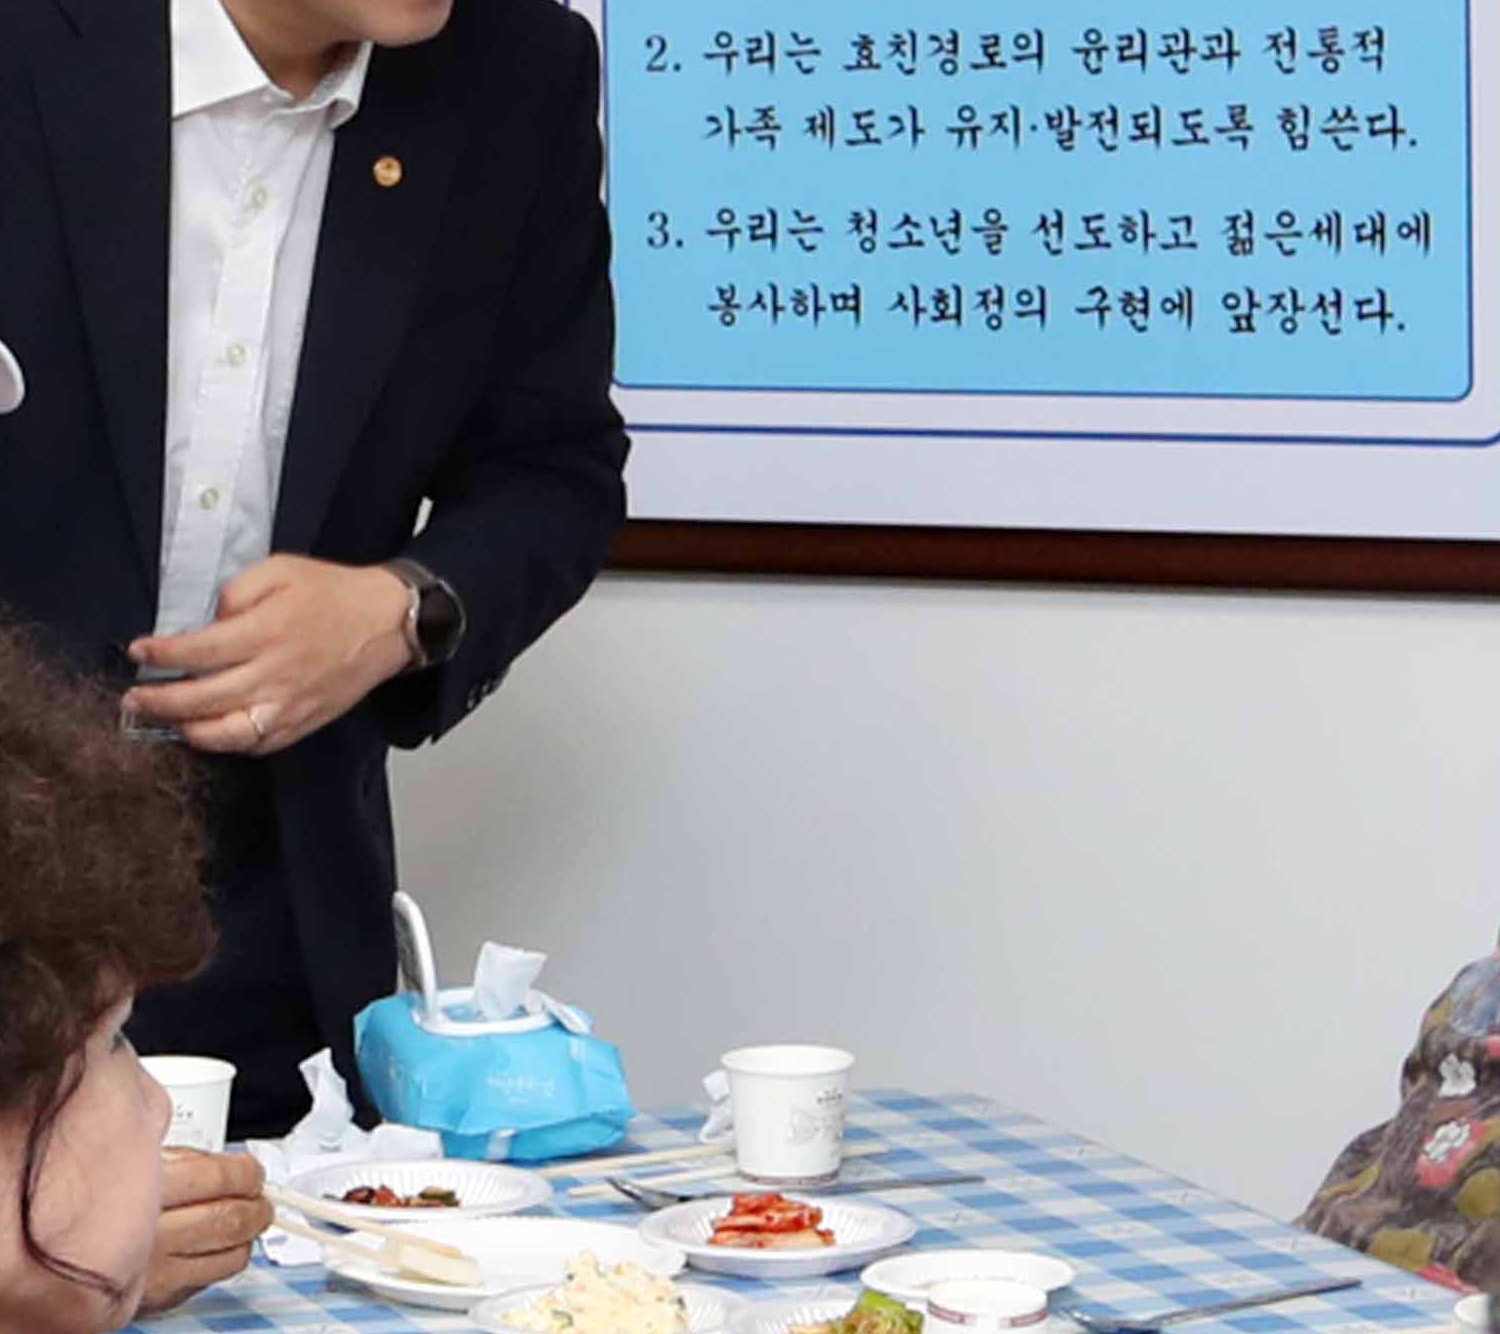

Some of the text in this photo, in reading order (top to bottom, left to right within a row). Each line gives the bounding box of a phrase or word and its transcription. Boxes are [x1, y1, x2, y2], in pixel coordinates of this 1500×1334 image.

[645, 25, 1385, 77] 2. 우리는 효친경로의 윤리관과 전통적
[1276, 103, 1417, 153] 힘쓴다.
[647, 207, 1431, 257] 3. 우리는 청소년을 선도하고 젊은세대에
[707, 282, 1405, 336] 봉사하며 사회정의 구현에 앞장선다.
